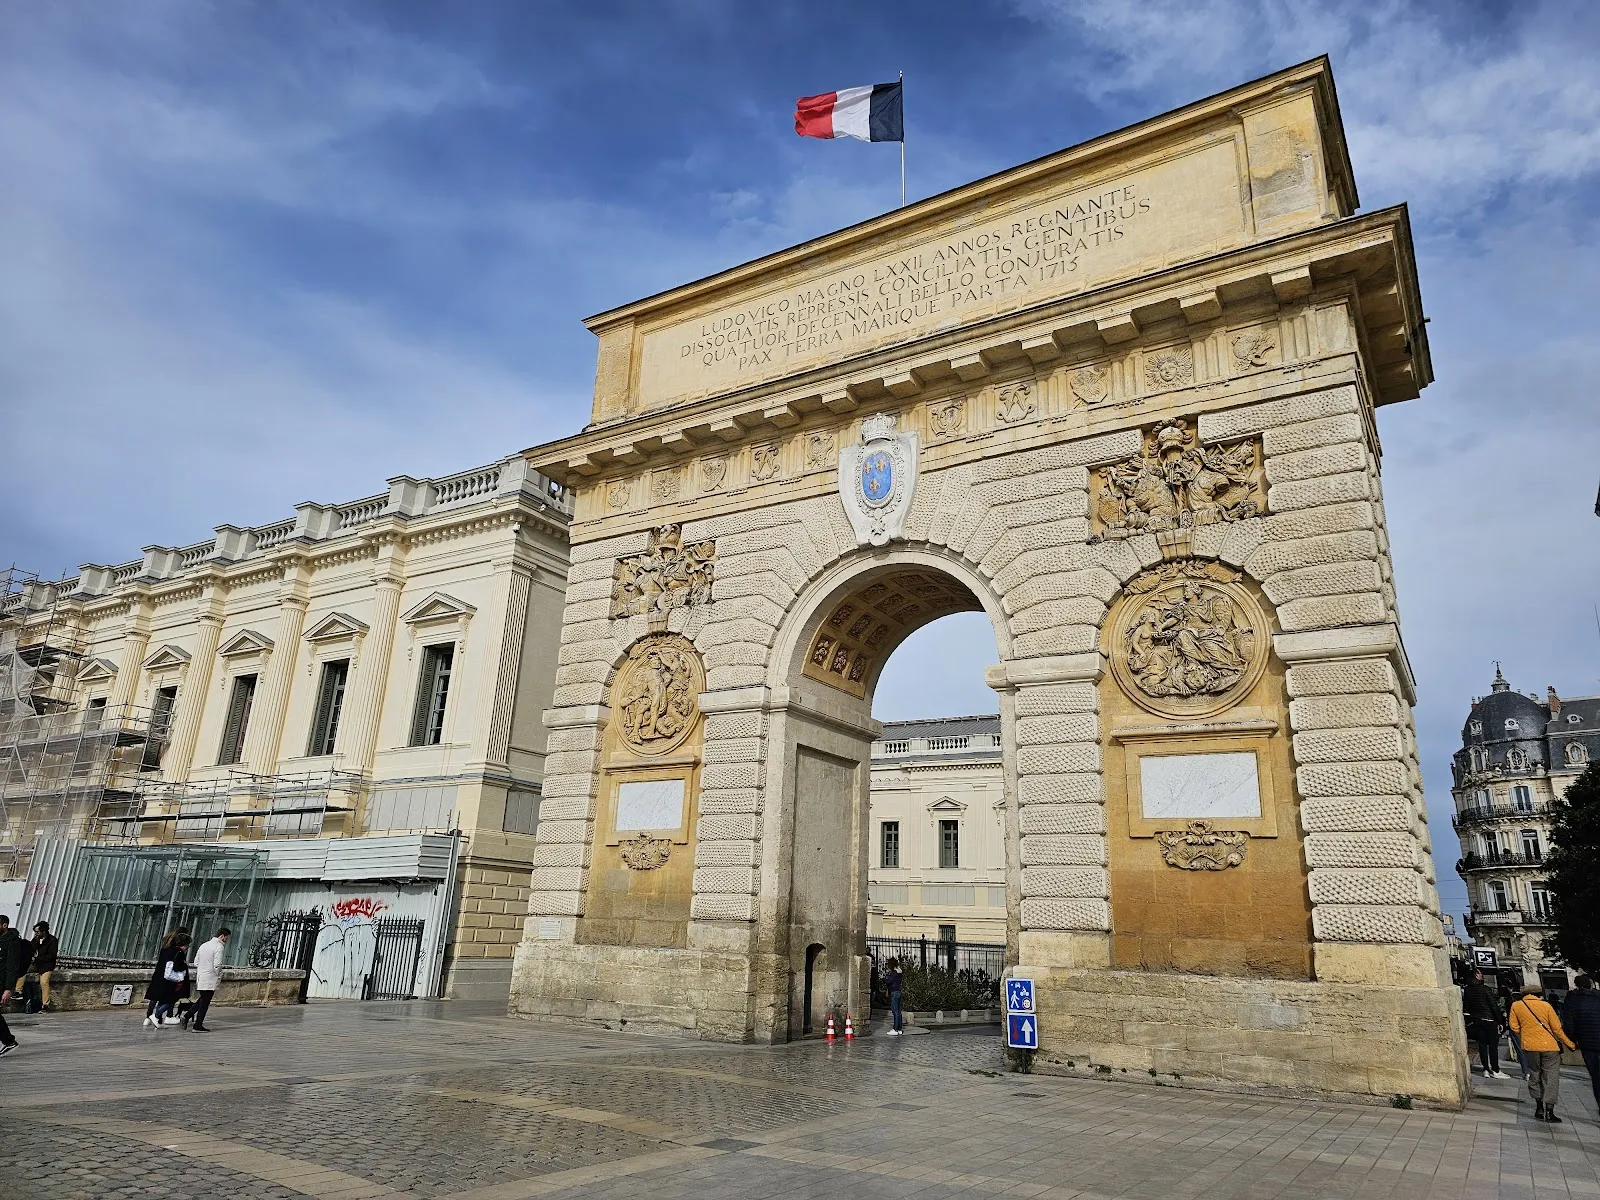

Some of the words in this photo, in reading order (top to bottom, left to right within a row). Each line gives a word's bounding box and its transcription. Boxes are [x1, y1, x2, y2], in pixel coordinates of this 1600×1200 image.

[681, 317, 779, 358] DISSOCIATIS
[787, 288, 869, 325] REPRESSIS
[879, 243, 1011, 295] CONCILIATIS
[1024, 198, 1150, 250] GENTIBUS
[702, 300, 789, 337] LUDOVICO
[797, 275, 865, 307] MAGNO
[874, 255, 922, 282] LXXII
[933, 230, 1001, 263] ANNOS
[1011, 184, 1136, 238] REGNANTE
[703, 330, 787, 366] QUATUOR
[797, 294, 901, 337] DECENNALI
[911, 273, 973, 303] BELLO
[985, 225, 1124, 279] CONJURATIS
[739, 349, 772, 370] PAX
[782, 330, 842, 356] TERRA
[853, 298, 940, 337] MARIQUE
[952, 274, 1028, 307] PARTA
[1040, 255, 1079, 281] 1715
[1477, 952, 1486, 962] P
